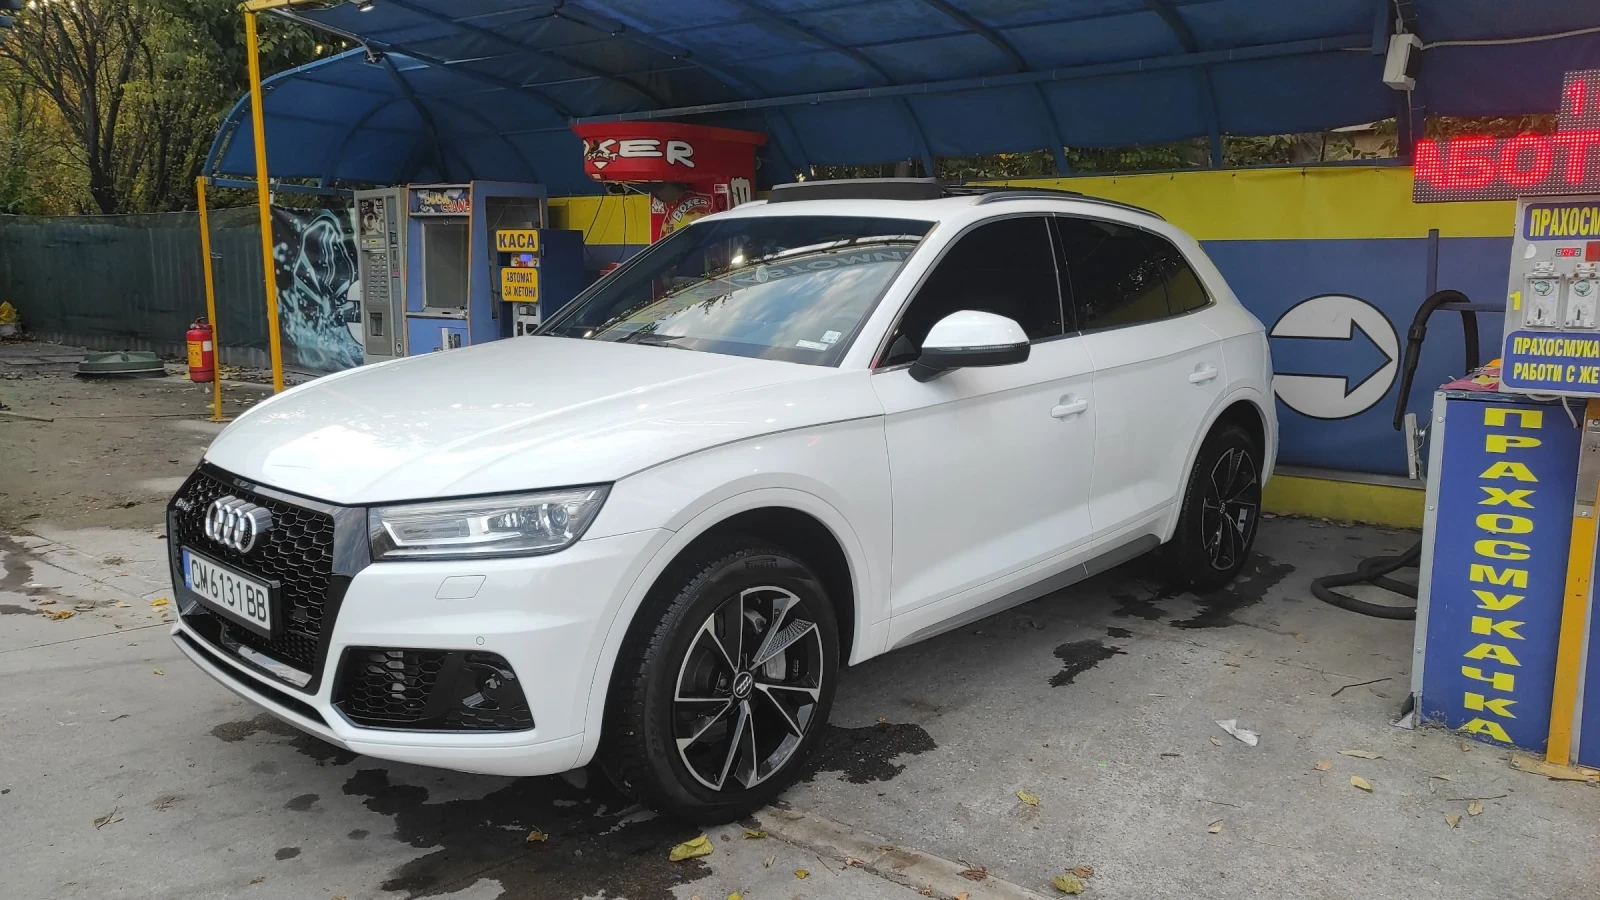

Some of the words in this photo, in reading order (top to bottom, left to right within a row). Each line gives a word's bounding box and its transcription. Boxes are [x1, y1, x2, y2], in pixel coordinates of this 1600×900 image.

[583, 138, 695, 168] XER
[672, 197, 708, 223] BOXER
[498, 233, 535, 248] КАСА
[506, 271, 533, 283] АВТОМАТ
[504, 285, 512, 297] ЗА
[513, 285, 536, 298] ЖЕТОНИ
[1509, 291, 1521, 311] 1
[1512, 336, 1600, 358] ПРАХОСМУКА
[1513, 362, 1563, 382] РАБОТИ
[1578, 366, 1599, 385] ЖЕ
